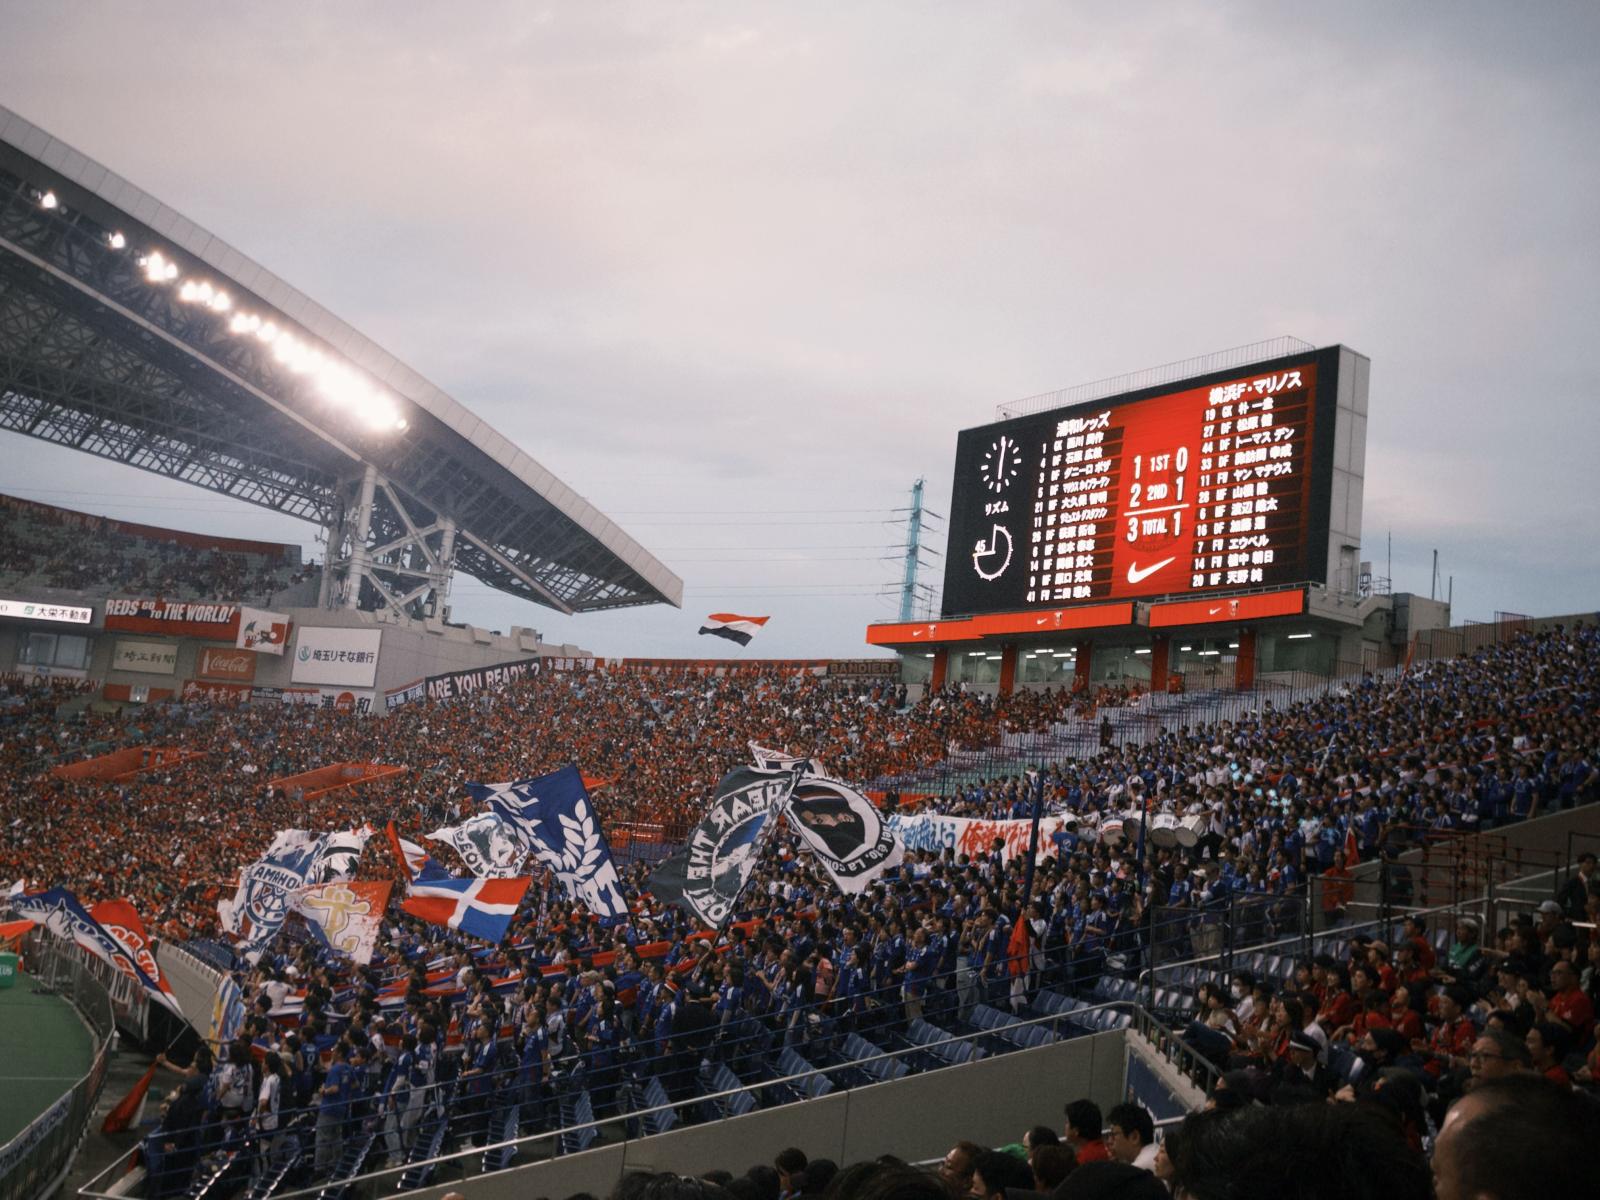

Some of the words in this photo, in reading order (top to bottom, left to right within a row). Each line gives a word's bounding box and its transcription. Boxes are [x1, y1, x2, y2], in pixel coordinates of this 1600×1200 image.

[1205, 408, 1216, 421] 19
[1056, 410, 1111, 437] 浦和レッズ
[1203, 425, 1215, 438] 27
[1202, 441, 1213, 454] 44
[1236, 431, 1272, 449] トーマス
[1274, 427, 1295, 442] デン
[1134, 455, 1142, 479] 1
[1150, 454, 1170, 472] 1ST
[1176, 446, 1188, 472] 0
[1200, 475, 1210, 487] 11
[1233, 469, 1252, 482] ヤン
[1254, 461, 1292, 477] マテウス
[1129, 483, 1142, 508] 2
[1147, 483, 1168, 501] 2ND
[1176, 476, 1184, 501] 1
[985, 500, 1009, 516] リズム
[1034, 502, 1043, 514] 21
[1199, 507, 1206, 520] 6
[1034, 516, 1042, 528] 11
[1127, 517, 1139, 542] 3
[1142, 517, 1168, 535] TOTAL
[1173, 511, 1181, 536] 1
[1197, 523, 1208, 537] 16
[975, 540, 986, 552] 45
[1197, 541, 1204, 553] 7
[1228, 534, 1269, 550] エウベル
[1030, 560, 1039, 571] 14
[1195, 557, 1205, 570] 14
[1192, 573, 1204, 587] 20
[1026, 590, 1036, 602] 41
[37, 607, 88, 620] 大栄不動産
[105, 600, 139, 616] REDS
[141, 601, 156, 610] GO
[150, 609, 162, 619] TO
[163, 603, 186, 620] THE
[186, 605, 235, 623] WORLD!
[312, 649, 375, 664] 埼玉りそな銀行
[428, 677, 453, 700] ARE
[454, 672, 482, 696] YOU
